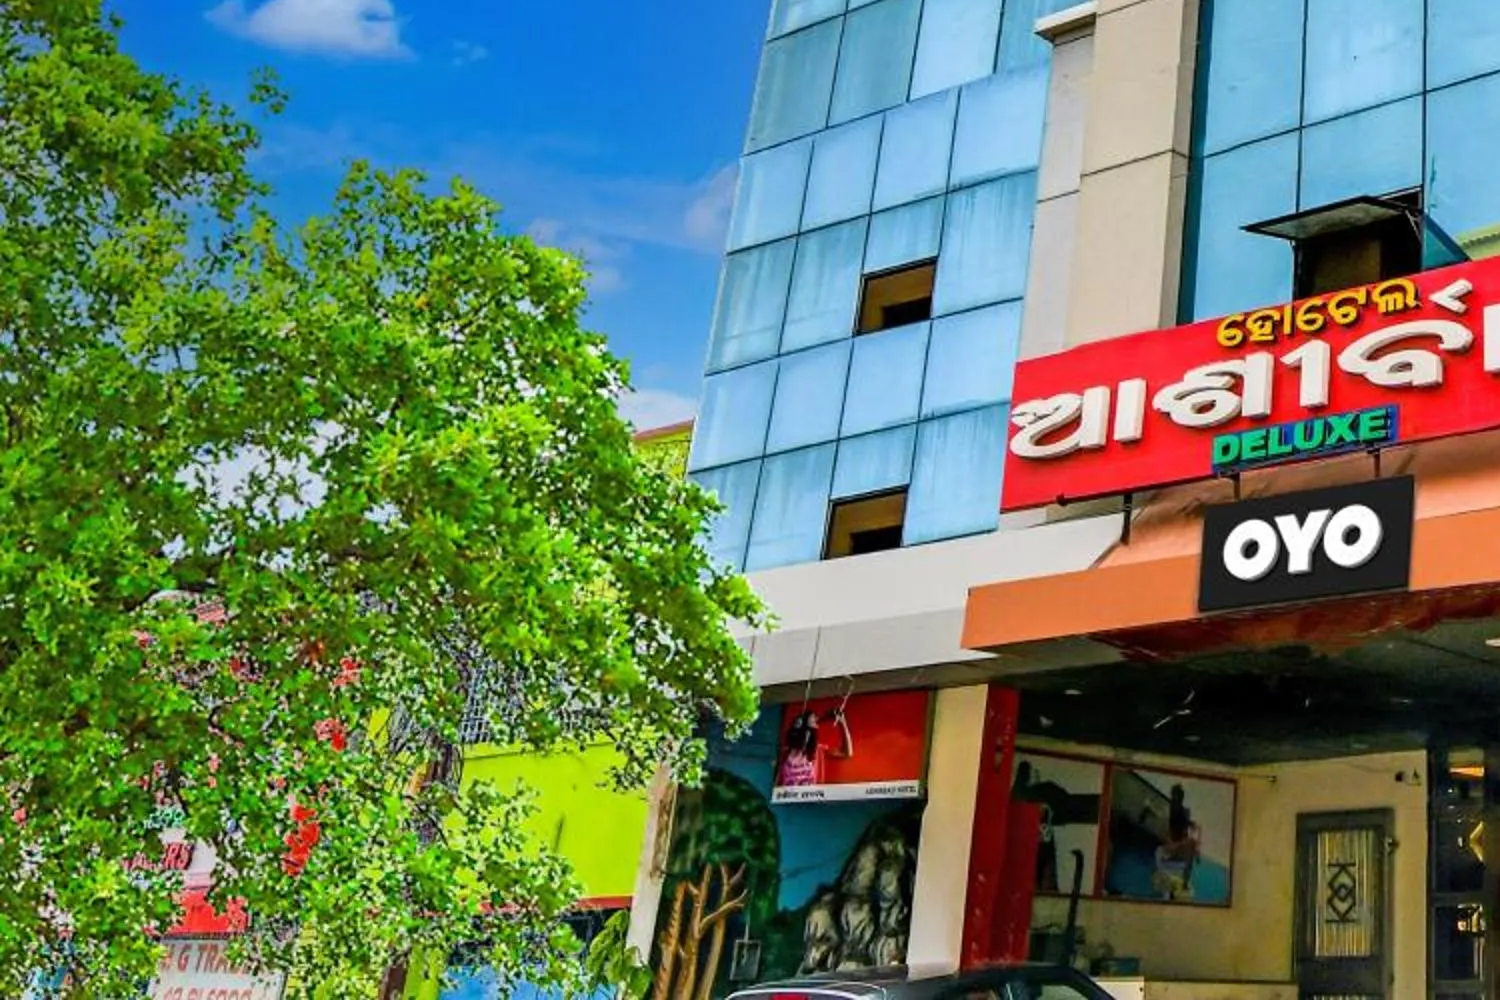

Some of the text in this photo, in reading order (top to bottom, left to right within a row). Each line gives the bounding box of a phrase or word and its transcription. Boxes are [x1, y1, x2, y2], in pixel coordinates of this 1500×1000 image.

[1216, 278, 1421, 348] ହୋଟେଲ
[1213, 407, 1389, 466] DELUXE
[1223, 504, 1383, 581] OYO
